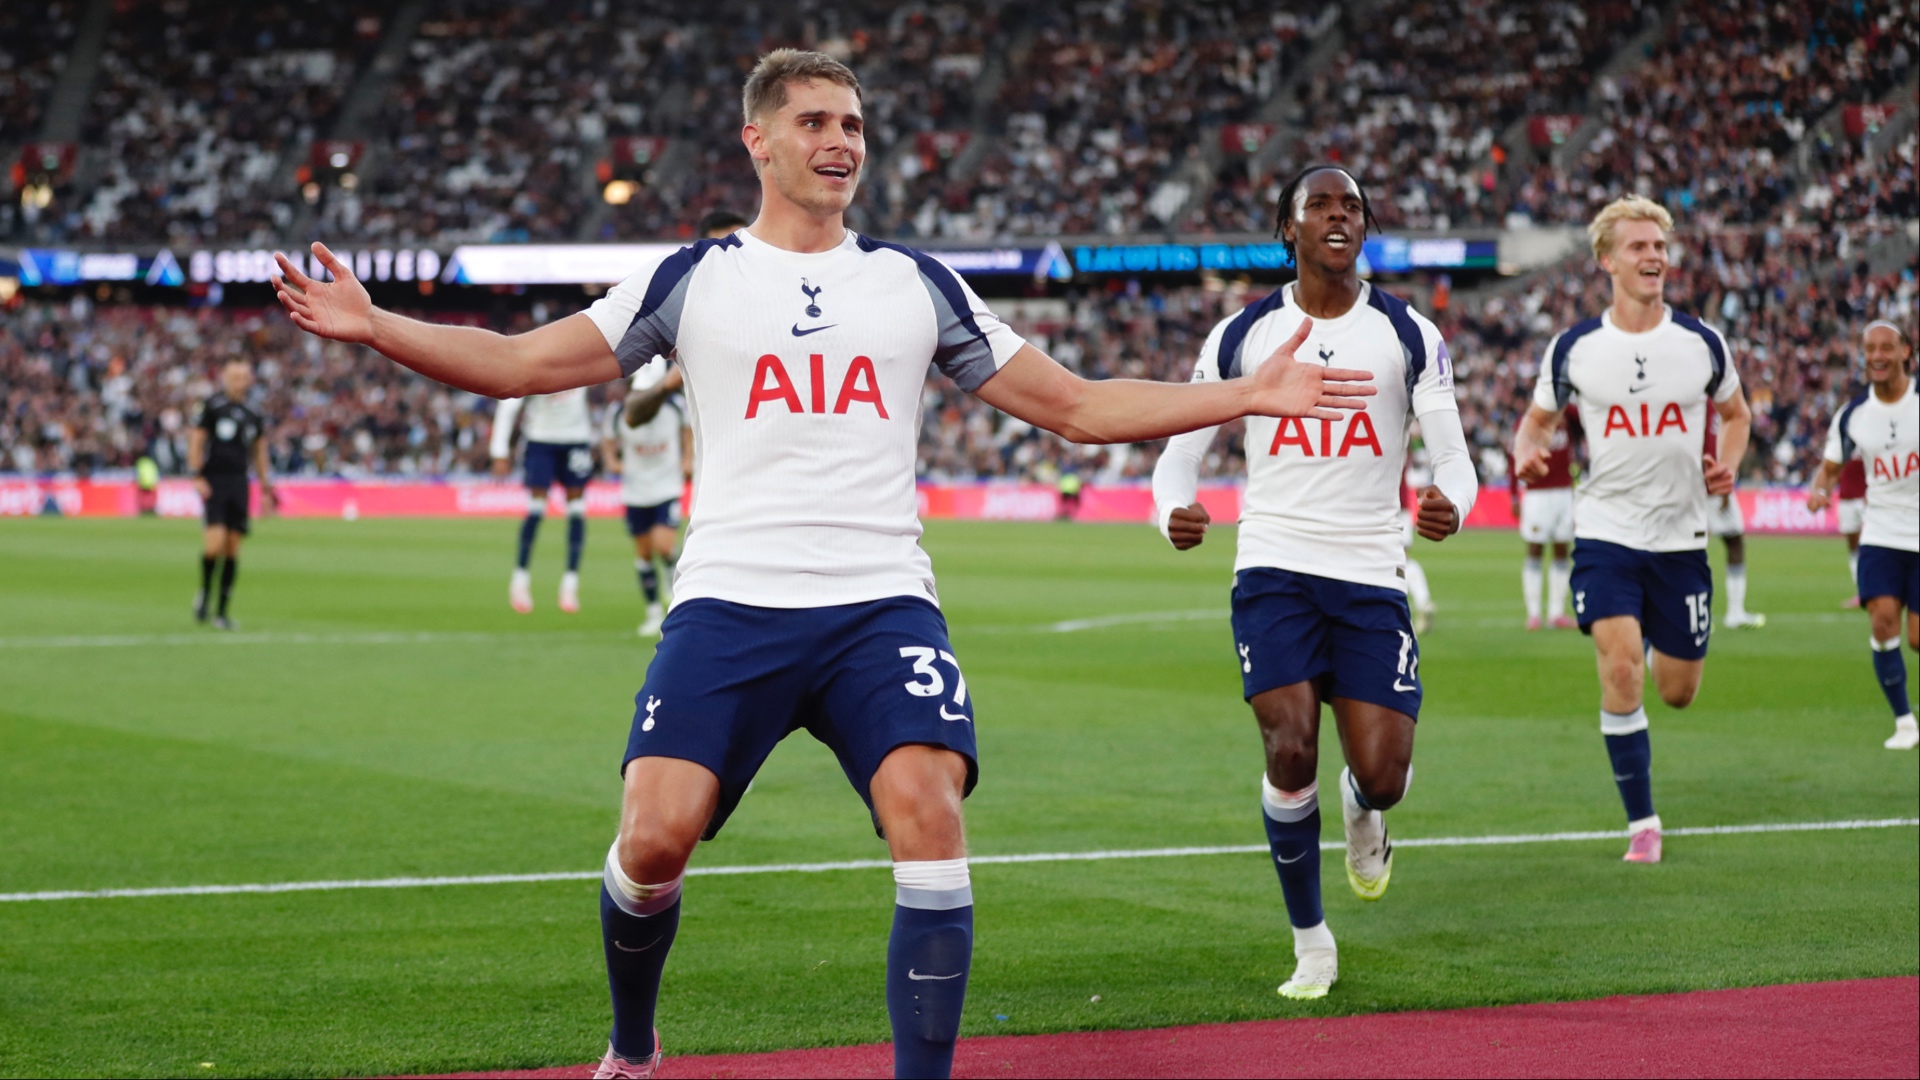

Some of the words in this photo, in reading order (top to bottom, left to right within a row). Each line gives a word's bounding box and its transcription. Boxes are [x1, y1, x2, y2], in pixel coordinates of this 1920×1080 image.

[744, 353, 890, 420] AIA
[1269, 411, 1383, 457] AIA
[1604, 401, 1688, 438] AIA
[1873, 451, 1919, 481] AIA
[1685, 591, 1709, 634] 15
[899, 646, 966, 707] 37
